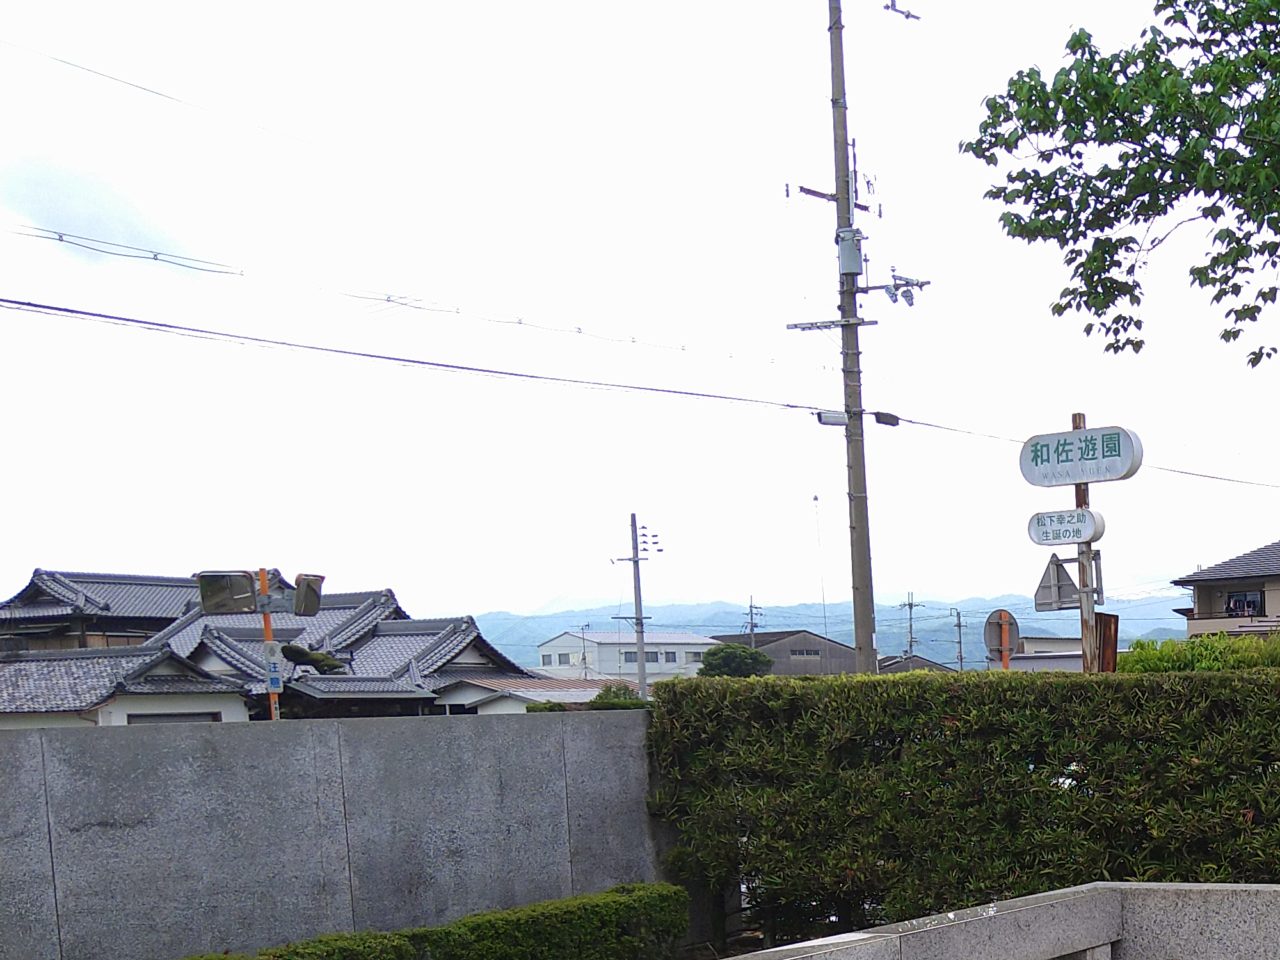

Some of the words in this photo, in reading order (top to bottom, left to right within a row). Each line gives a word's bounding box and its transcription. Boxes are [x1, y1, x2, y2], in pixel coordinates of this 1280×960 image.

[1031, 433, 1121, 467] 和佐遊園
[1042, 469, 1071, 480] WASA
[1037, 513, 1086, 527] 松下幸之助
[1042, 528, 1081, 541] 生誕の地
